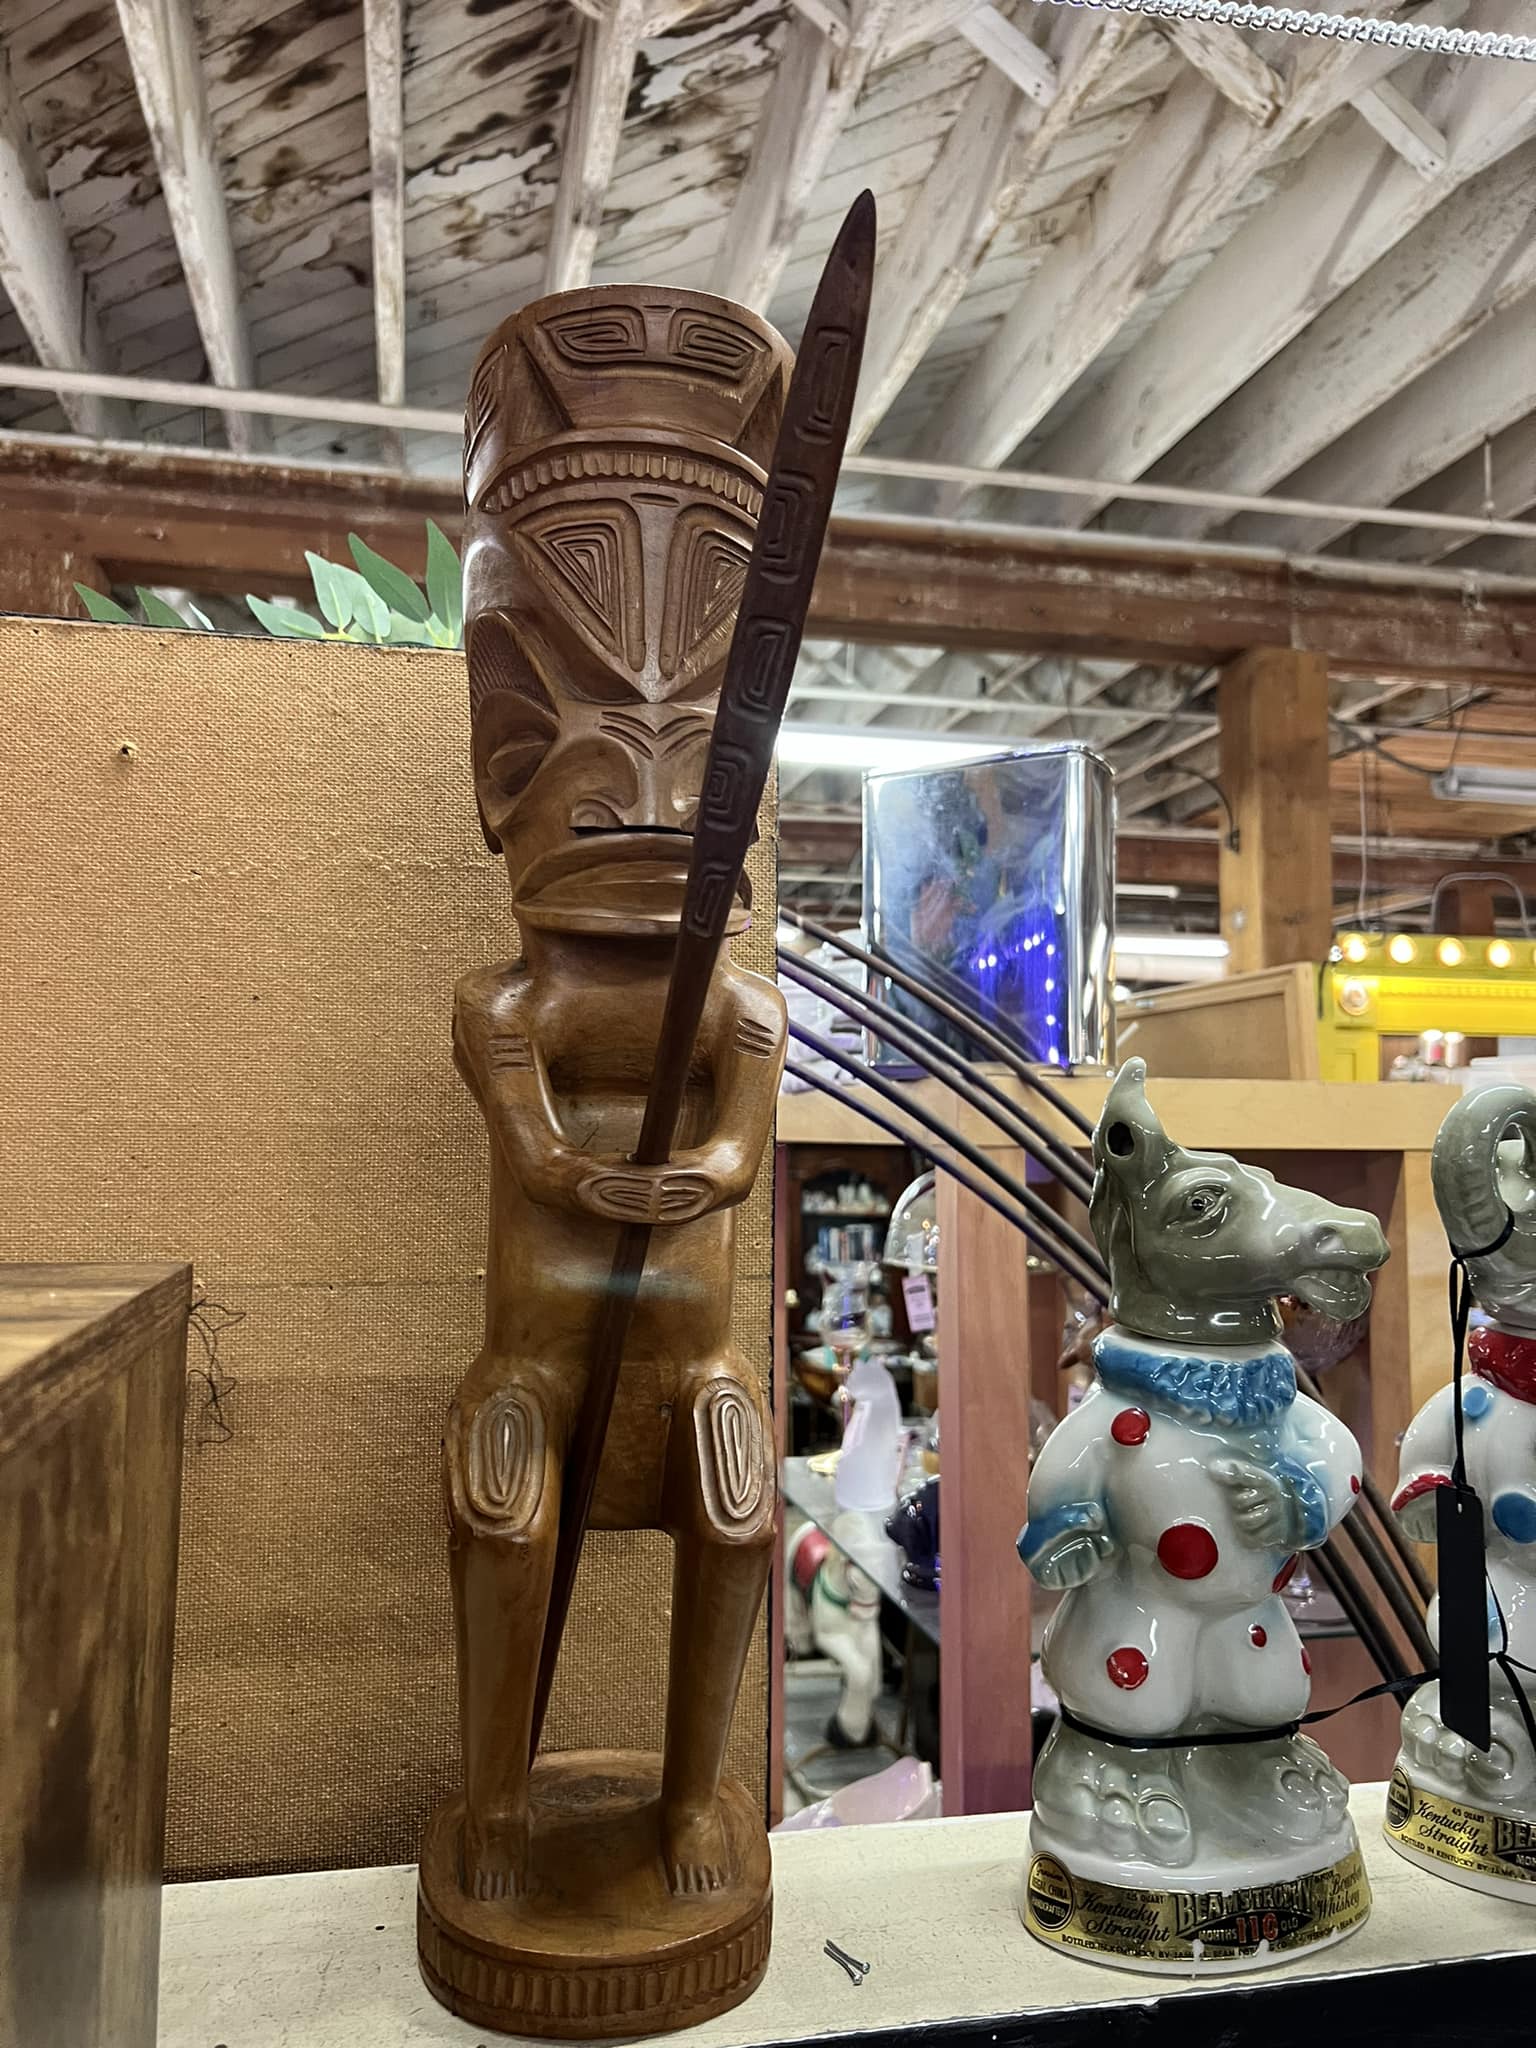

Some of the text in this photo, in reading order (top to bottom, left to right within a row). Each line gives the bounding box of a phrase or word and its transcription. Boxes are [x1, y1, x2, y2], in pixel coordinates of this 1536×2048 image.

[1413, 1799, 1480, 1842] Kentucky
[1400, 1833, 1426, 1851] BOTTLED
[1435, 1848, 1475, 1868] KENTUCKY
[1418, 1824, 1489, 1858] Straight
[1076, 1891, 1160, 1926] Kentucky
[1140, 1894, 1165, 1905] QUART
[1315, 1889, 1360, 1921] Whiskey
[1061, 1933, 1095, 1950] BOTTLED
[1158, 1950, 1170, 1958] BY
[1086, 1916, 1170, 1945] Straight
[1198, 1927, 1238, 1943] MONTHS
[1280, 1916, 1299, 1932] OLD
